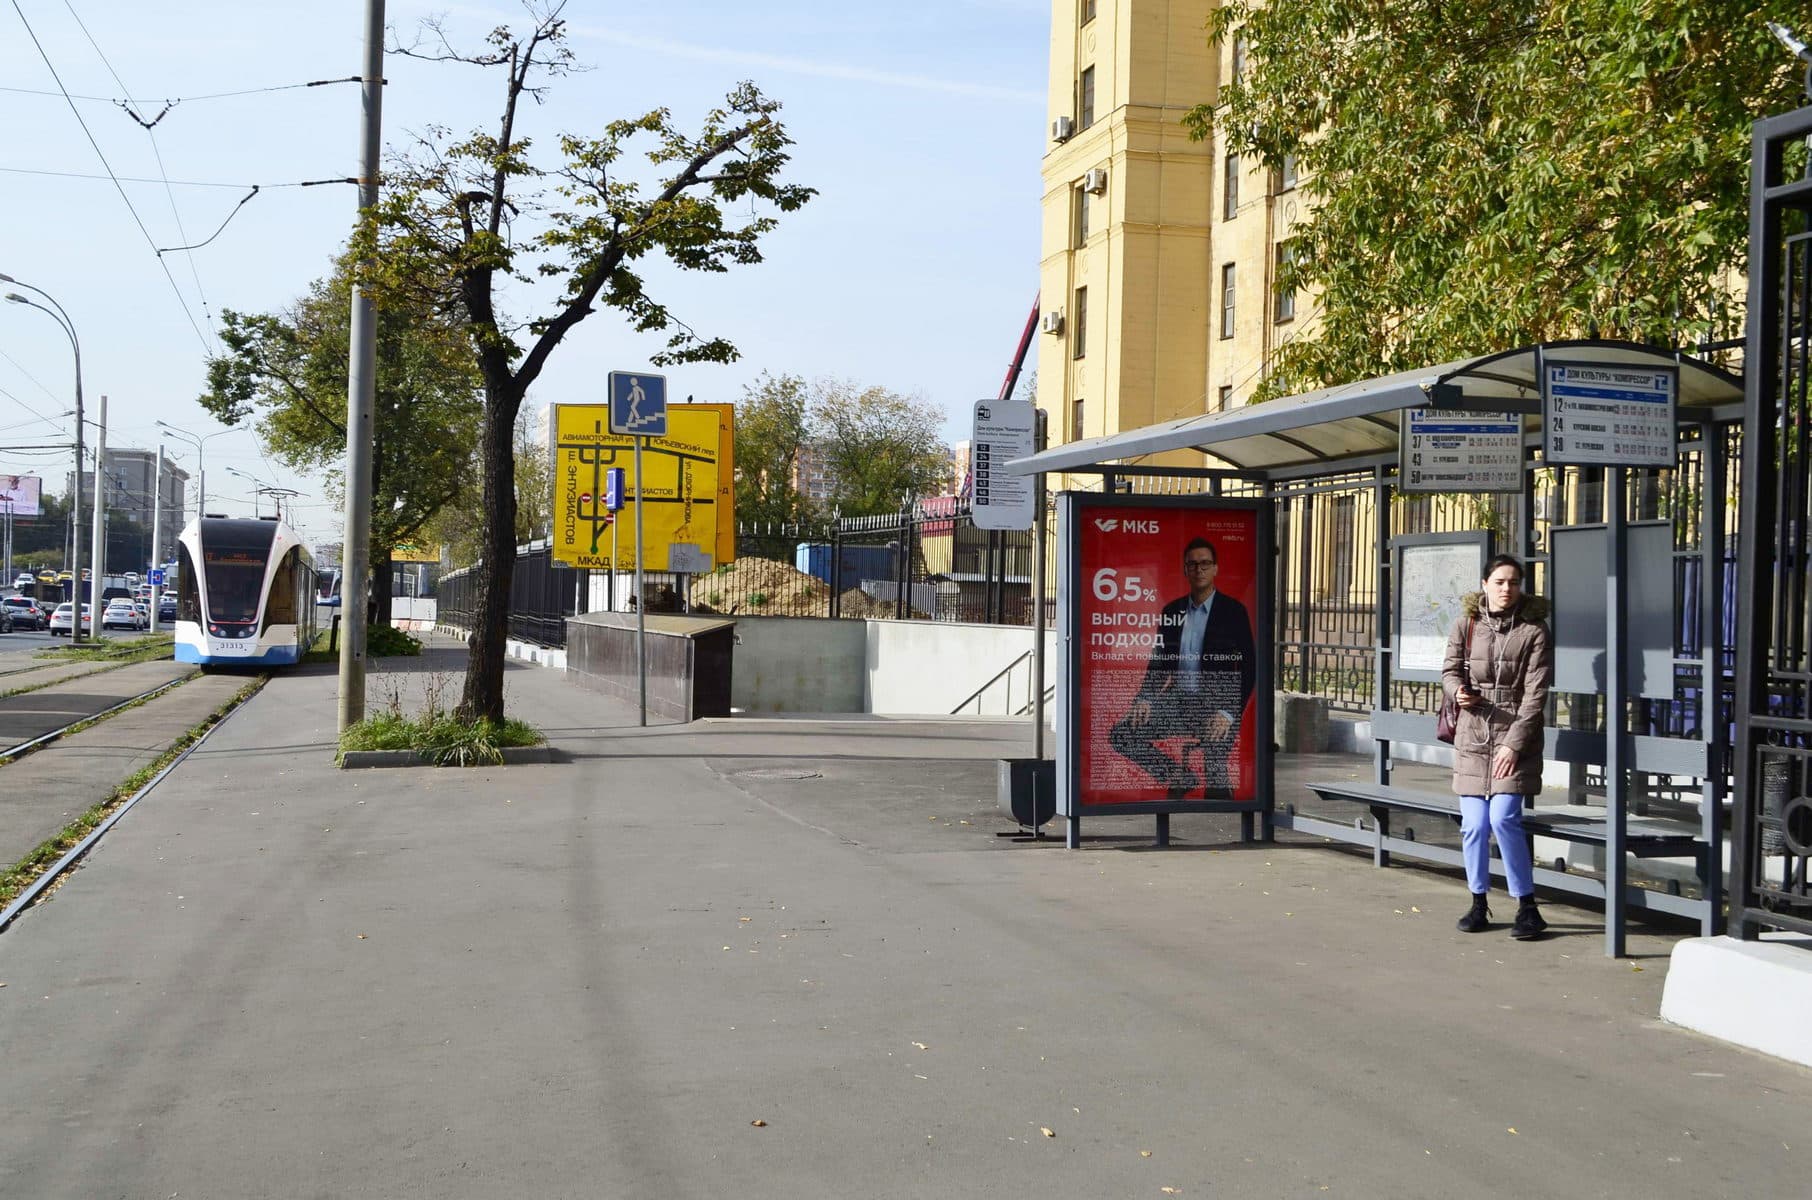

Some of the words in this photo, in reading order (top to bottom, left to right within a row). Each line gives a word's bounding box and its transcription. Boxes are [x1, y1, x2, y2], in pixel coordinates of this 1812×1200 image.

[1553, 397, 1563, 412] 12
[1553, 417, 1563, 432] 24
[563, 433, 624, 443] АВИАМОТОРНАЯ
[1412, 435, 1421, 449] 37
[1553, 437, 1563, 452] 38
[653, 438, 701, 452] ЮРЬЕВСКИЙ
[702, 448, 715, 456] пер.
[568, 450, 577, 463] ш.
[1412, 453, 1421, 466] 43
[1411, 471, 1421, 484] 50
[565, 465, 578, 546] ЭНТУЗИАСТОВ
[1123, 520, 1160, 534] МКБ
[577, 555, 611, 567] МКАД
[1091, 610, 1189, 629] ВЫГОДНЫЙ
[220, 642, 244, 650] 31313
[1091, 633, 1165, 649] ПОДХОД
[1091, 651, 1124, 662] Вклад
[1126, 654, 1133, 662] с
[1135, 651, 1201, 662] повышенной
[1203, 652, 1243, 662] ставкой
